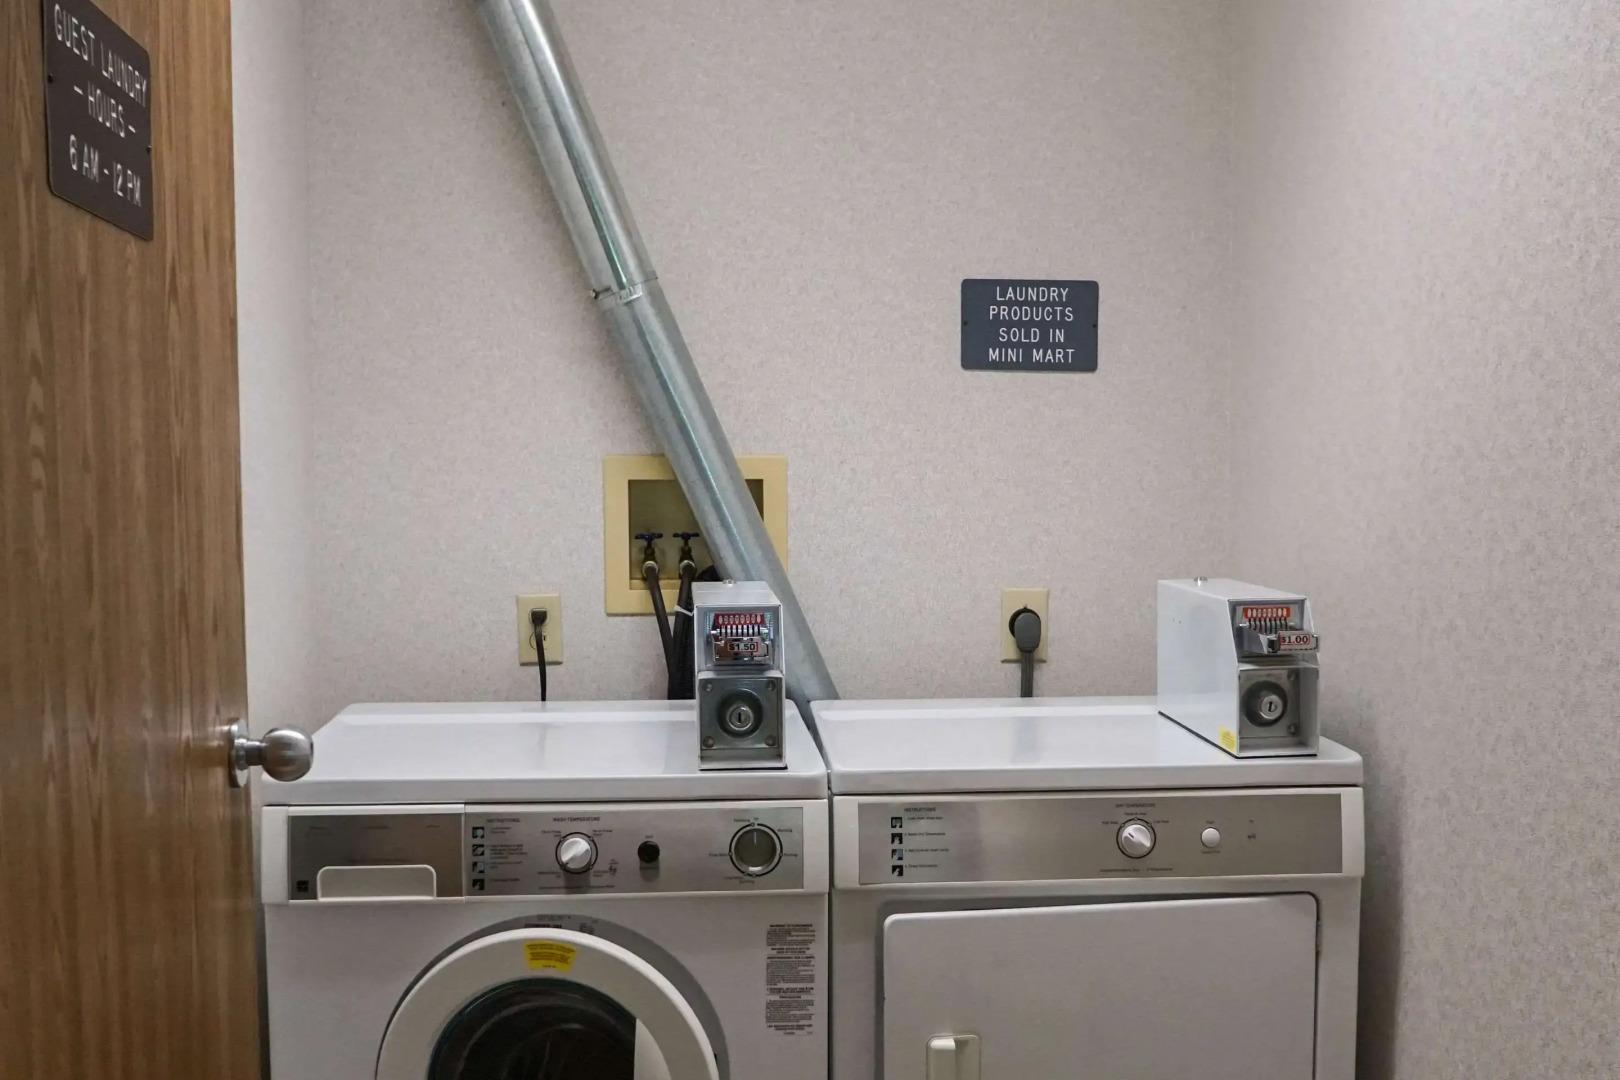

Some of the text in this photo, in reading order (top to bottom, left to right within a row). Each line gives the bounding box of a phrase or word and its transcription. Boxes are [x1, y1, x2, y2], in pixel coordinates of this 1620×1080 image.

[54, 3, 147, 107] GUEST LAUNDRY
[87, 80, 126, 138] HOURS
[69, 134, 78, 171] 6
[82, 143, 99, 183] AM
[112, 161, 124, 197] 12
[126, 169, 142, 207] PM
[996, 286, 1069, 302] LAUNDRY
[989, 305, 1074, 322] PRODUCTS
[998, 327, 1065, 343] SOLD IN
[988, 347, 1076, 364] MINI MART
[728, 643, 756, 651] $1.50
[1281, 635, 1309, 645] $1.00
